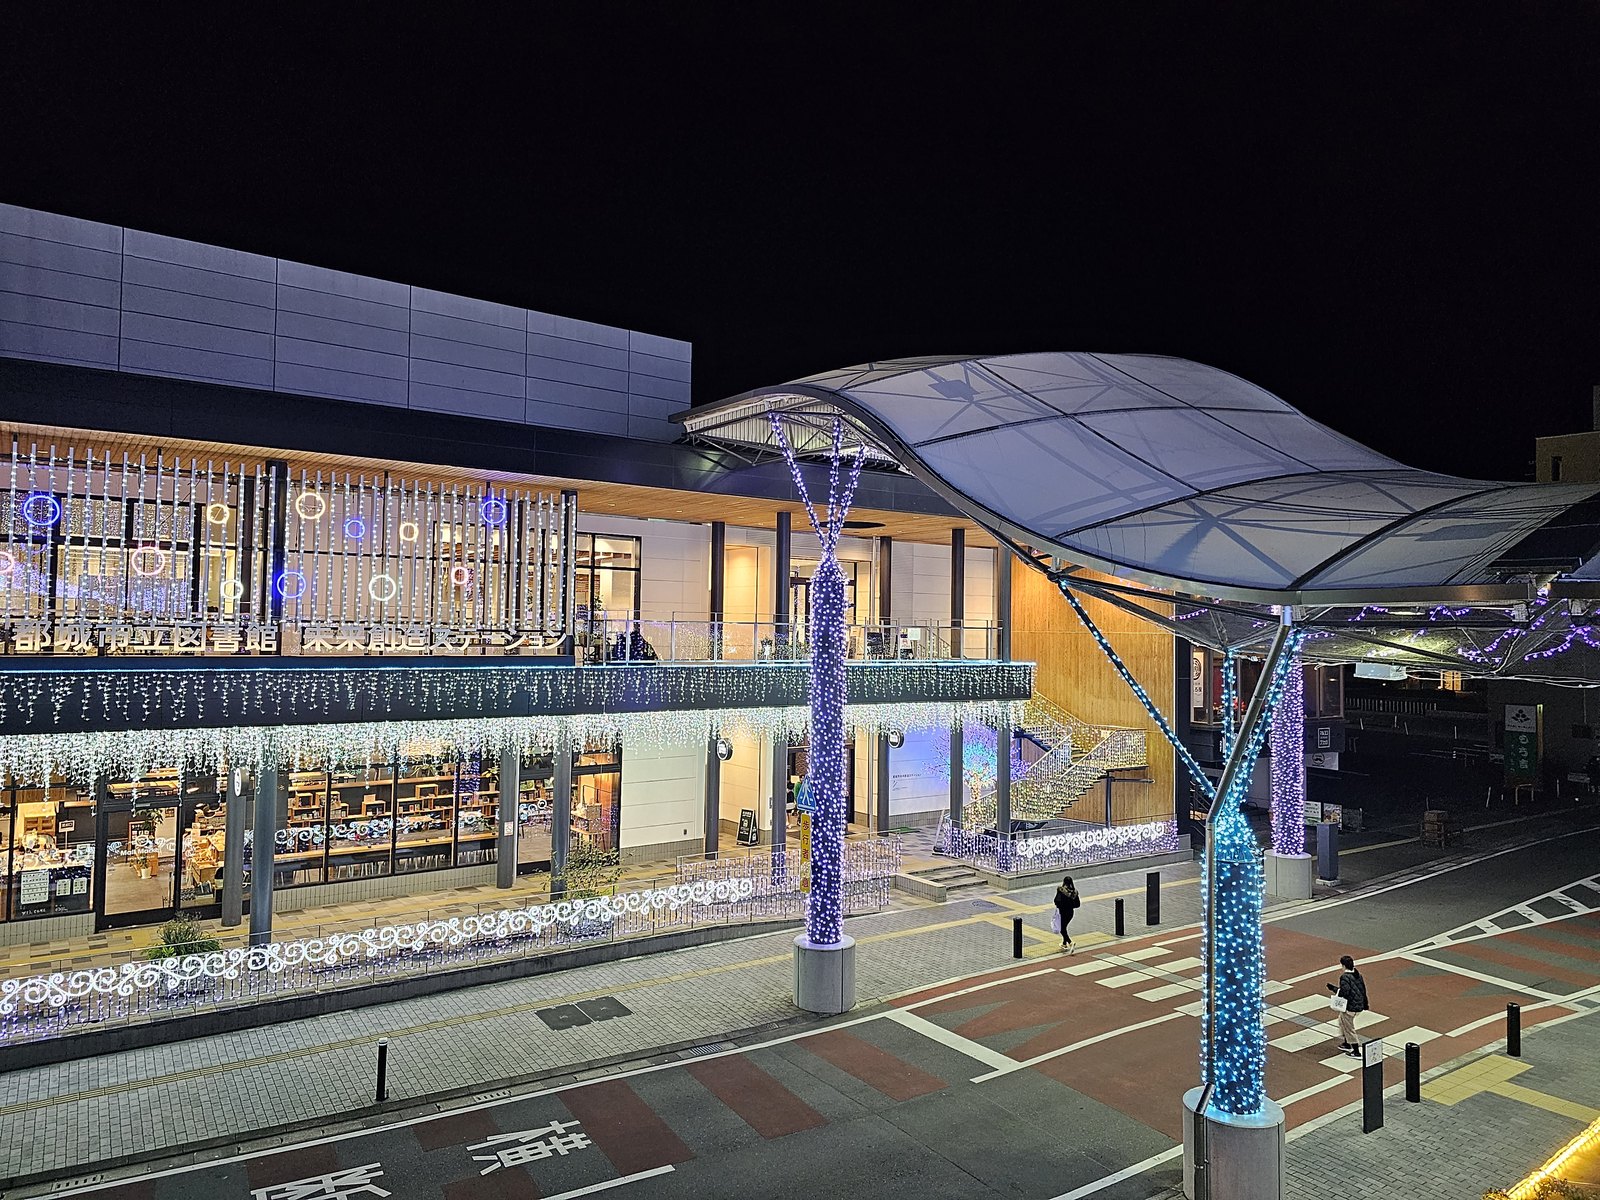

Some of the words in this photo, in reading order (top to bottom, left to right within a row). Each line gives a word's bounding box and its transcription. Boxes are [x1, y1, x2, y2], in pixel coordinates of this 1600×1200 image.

[11, 620, 279, 652] 都城市立図書館
[301, 625, 567, 652] 未来創造ステーション
